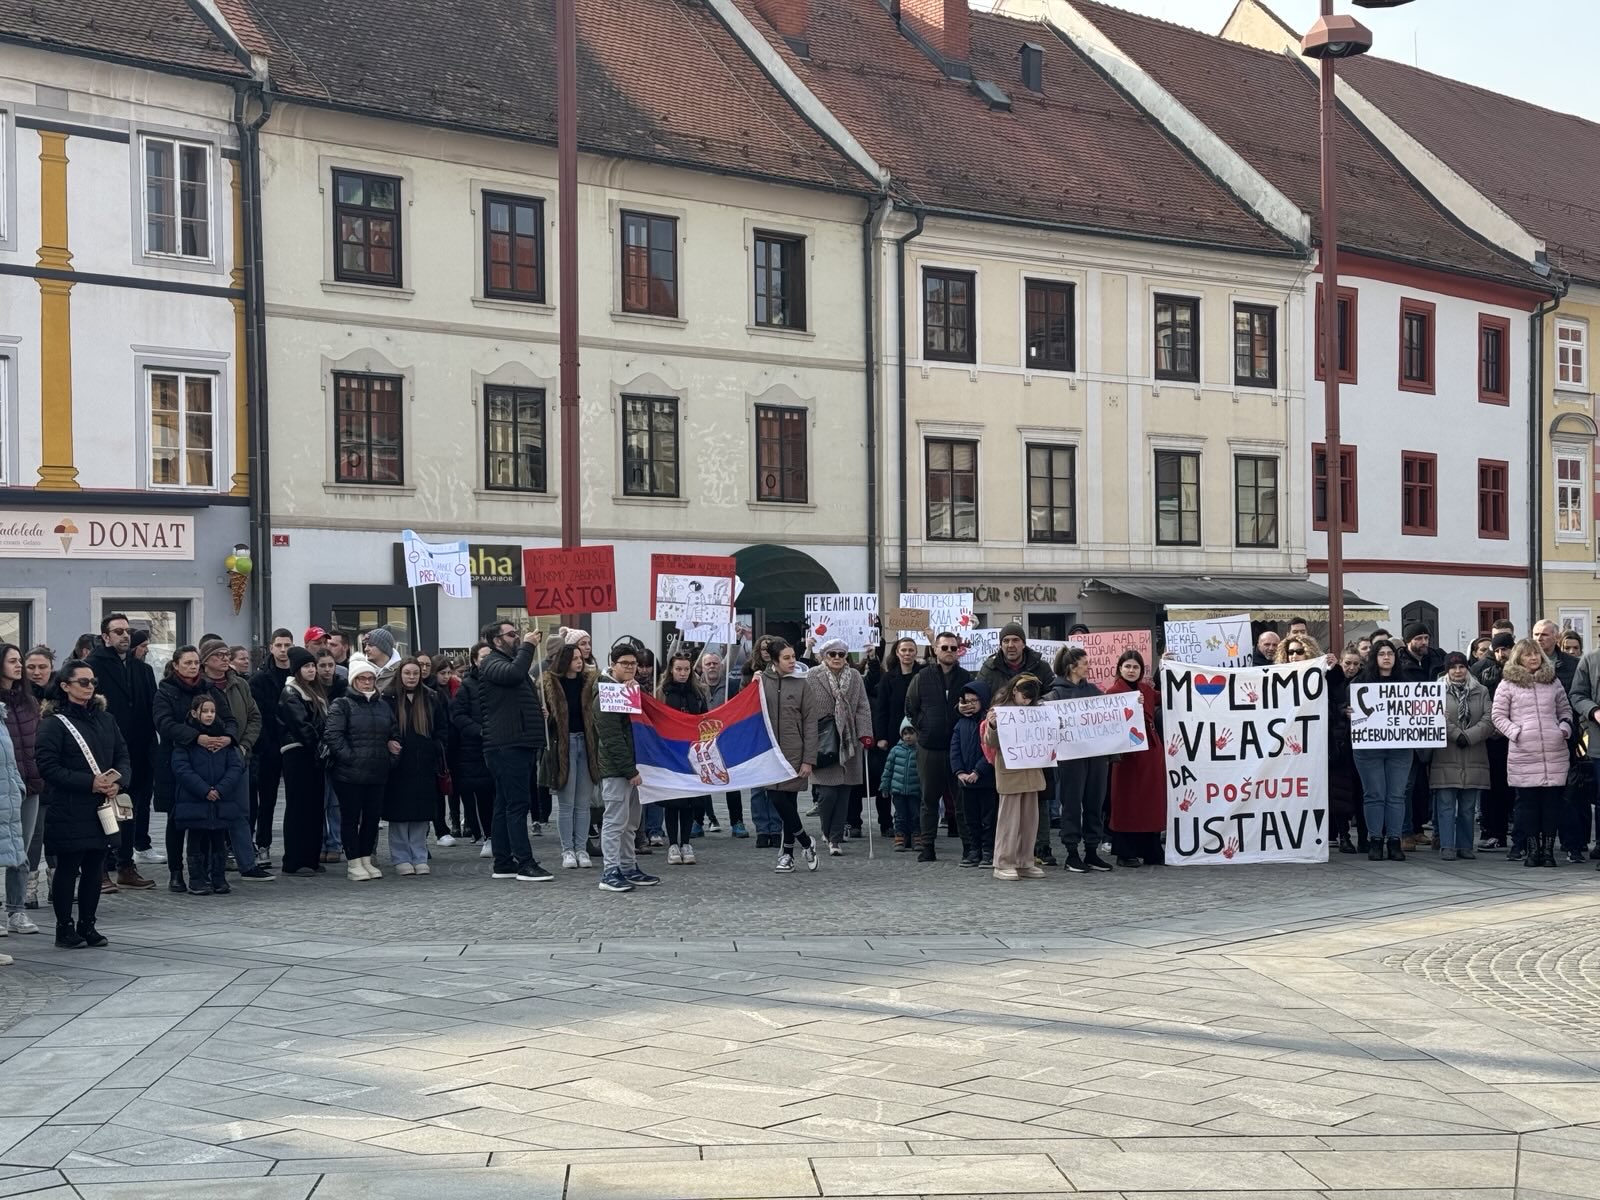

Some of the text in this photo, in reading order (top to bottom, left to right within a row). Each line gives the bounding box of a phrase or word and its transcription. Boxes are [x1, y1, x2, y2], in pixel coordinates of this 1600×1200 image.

[88, 521, 186, 549] DONAT
[468, 548, 512, 575] aha
[534, 584, 612, 610] ZAŠTO!
[1013, 583, 1057, 602] SVEČAR
[1113, 633, 1136, 644] КАД
[1167, 634, 1201, 645] НЕКАД
[1084, 644, 1116, 656] СТОЈАЛА
[1168, 644, 1202, 655] НЕШТО
[1185, 654, 1198, 664] СЕ
[1087, 665, 1116, 681] ДНОС
[1166, 667, 1324, 711] MLIMO
[1379, 682, 1441, 698] HALO ĆACI
[1000, 711, 1016, 725] ZA
[1019, 708, 1026, 723] 9
[1375, 700, 1444, 716] IZ MARIBORA
[1080, 709, 1122, 726] STUDENTI
[1387, 717, 1400, 726] SE
[1178, 714, 1320, 762] VLAST
[1168, 765, 1197, 789] DA
[1206, 776, 1309, 803] POŠTUJE
[1174, 809, 1325, 856] USTAV!
